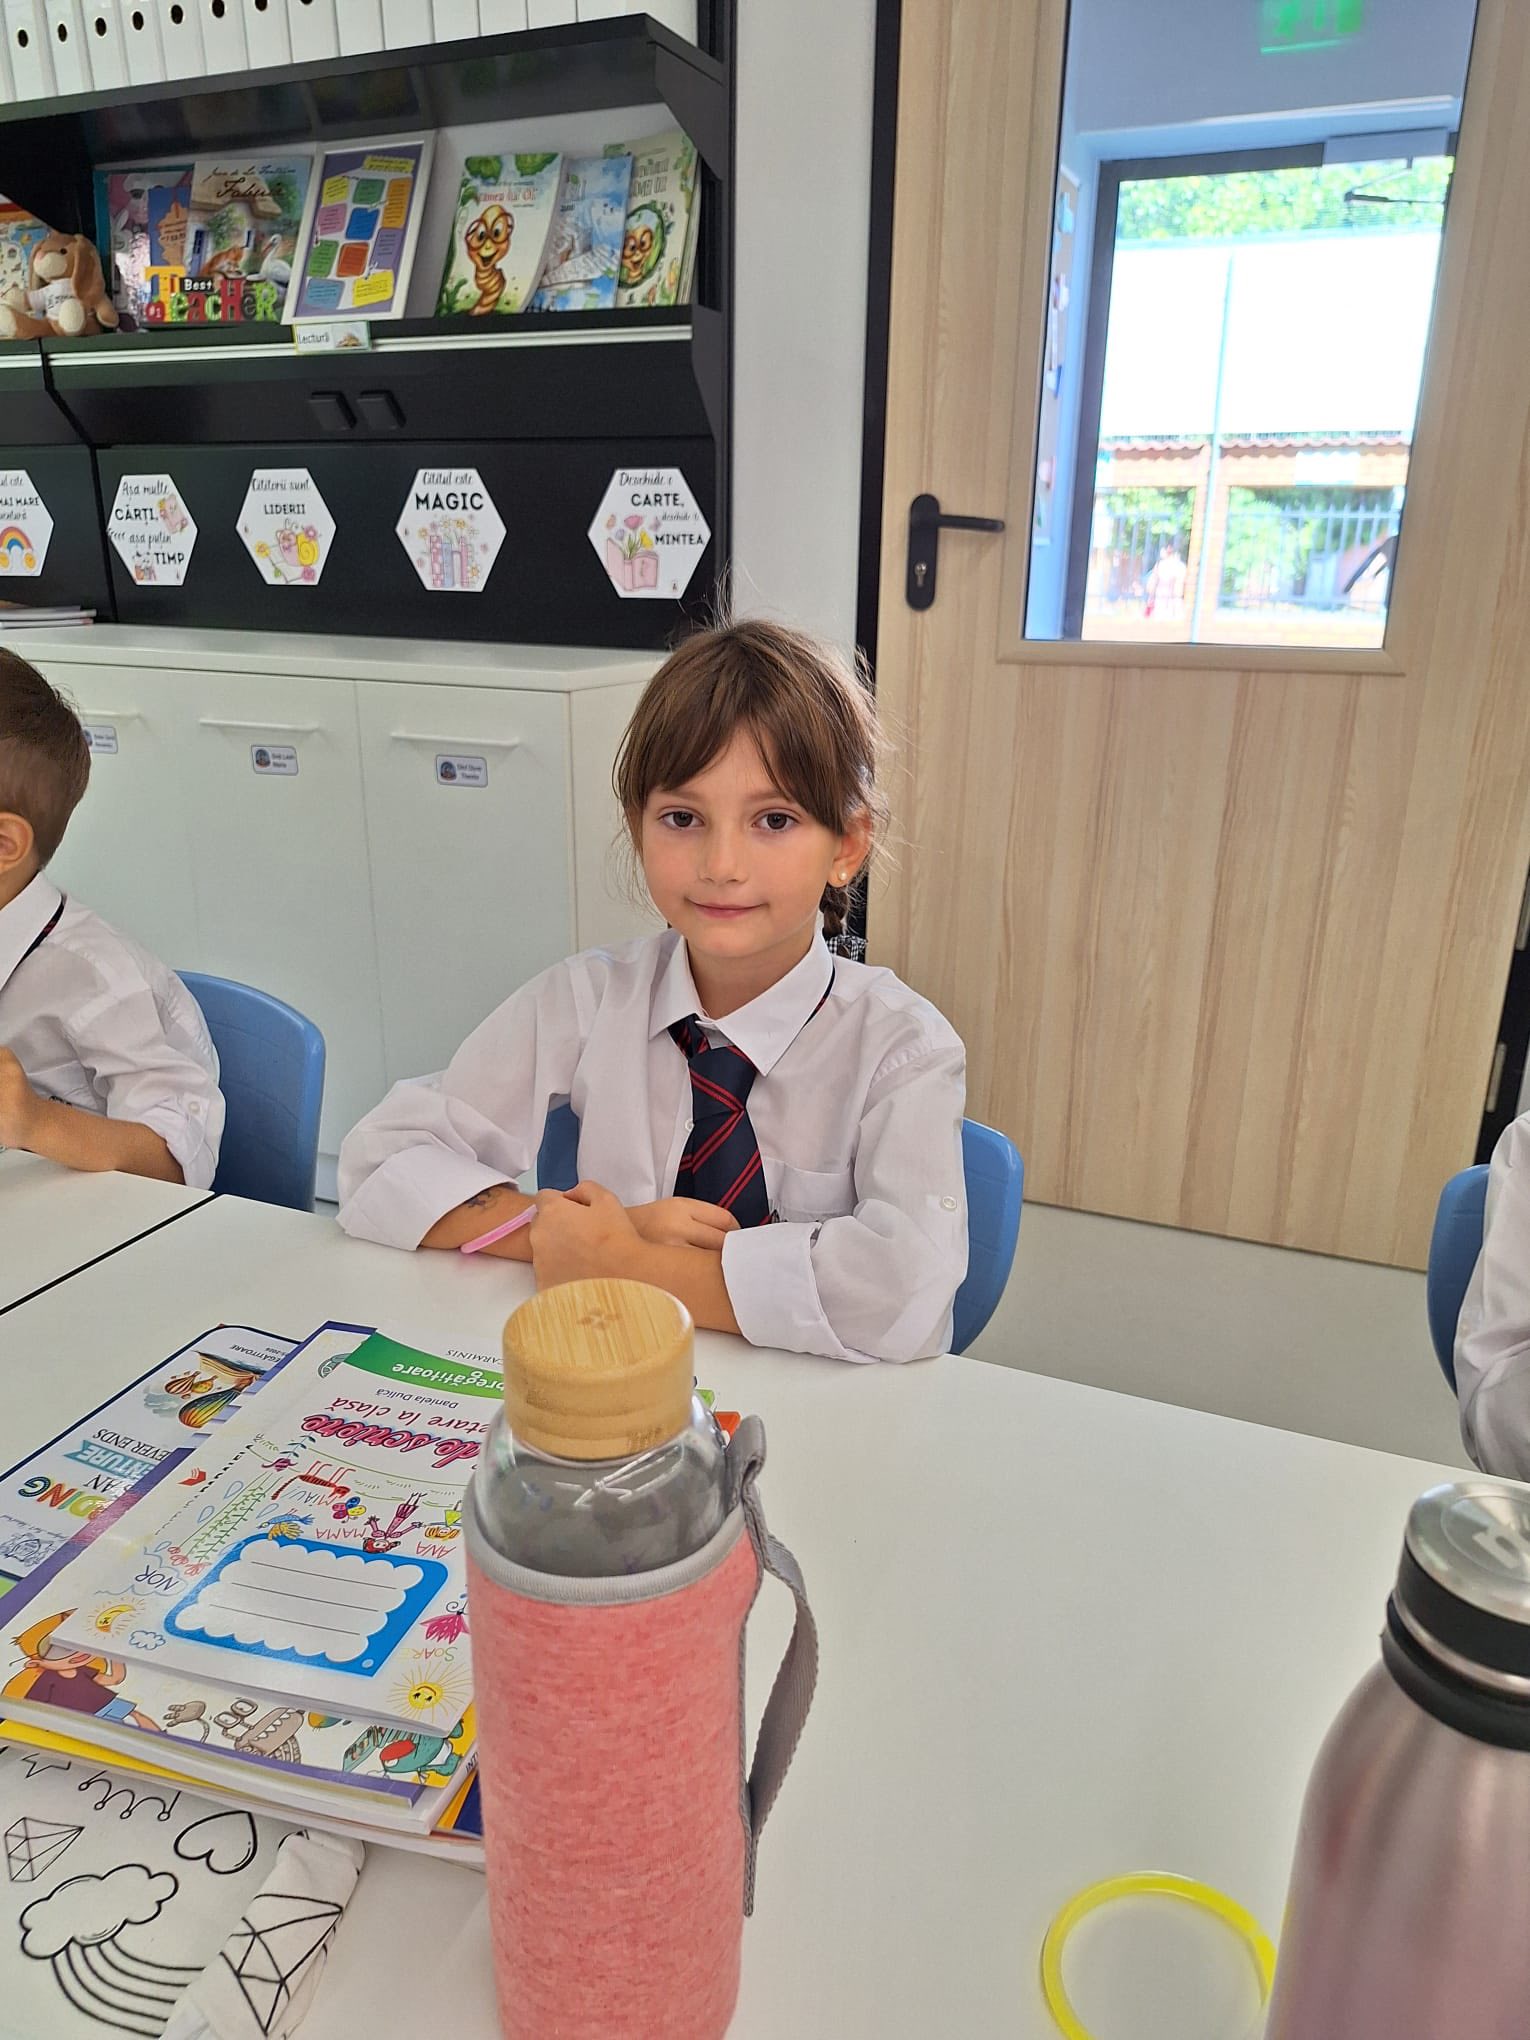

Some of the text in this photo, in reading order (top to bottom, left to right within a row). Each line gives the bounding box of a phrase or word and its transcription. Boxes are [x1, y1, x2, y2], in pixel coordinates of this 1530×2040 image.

[184, 278, 213, 291] Best
[149, 306, 162, 319] #1
[264, 503, 306, 516] LIDERII
[415, 491, 485, 512] MAGIC
[630, 492, 685, 508] CARTE,
[655, 533, 705, 546] MINTEA
[154, 552, 185, 566] TIMP
[230, 1344, 281, 1363] EGĂTITOARE
[375, 1387, 460, 1410] Daniela Dulică
[399, 1409, 422, 1427] la
[427, 1414, 491, 1435] etare
[301, 1412, 442, 1454] scriere
[93, 1428, 170, 1462] EVER ENDS
[431, 1437, 481, 1469] de
[83, 1473, 116, 1494] AN
[18, 1476, 102, 1519] DING
[316, 1527, 367, 1541] MAMA
[415, 1541, 457, 1560] ANA
[134, 1564, 180, 1592] NOR
